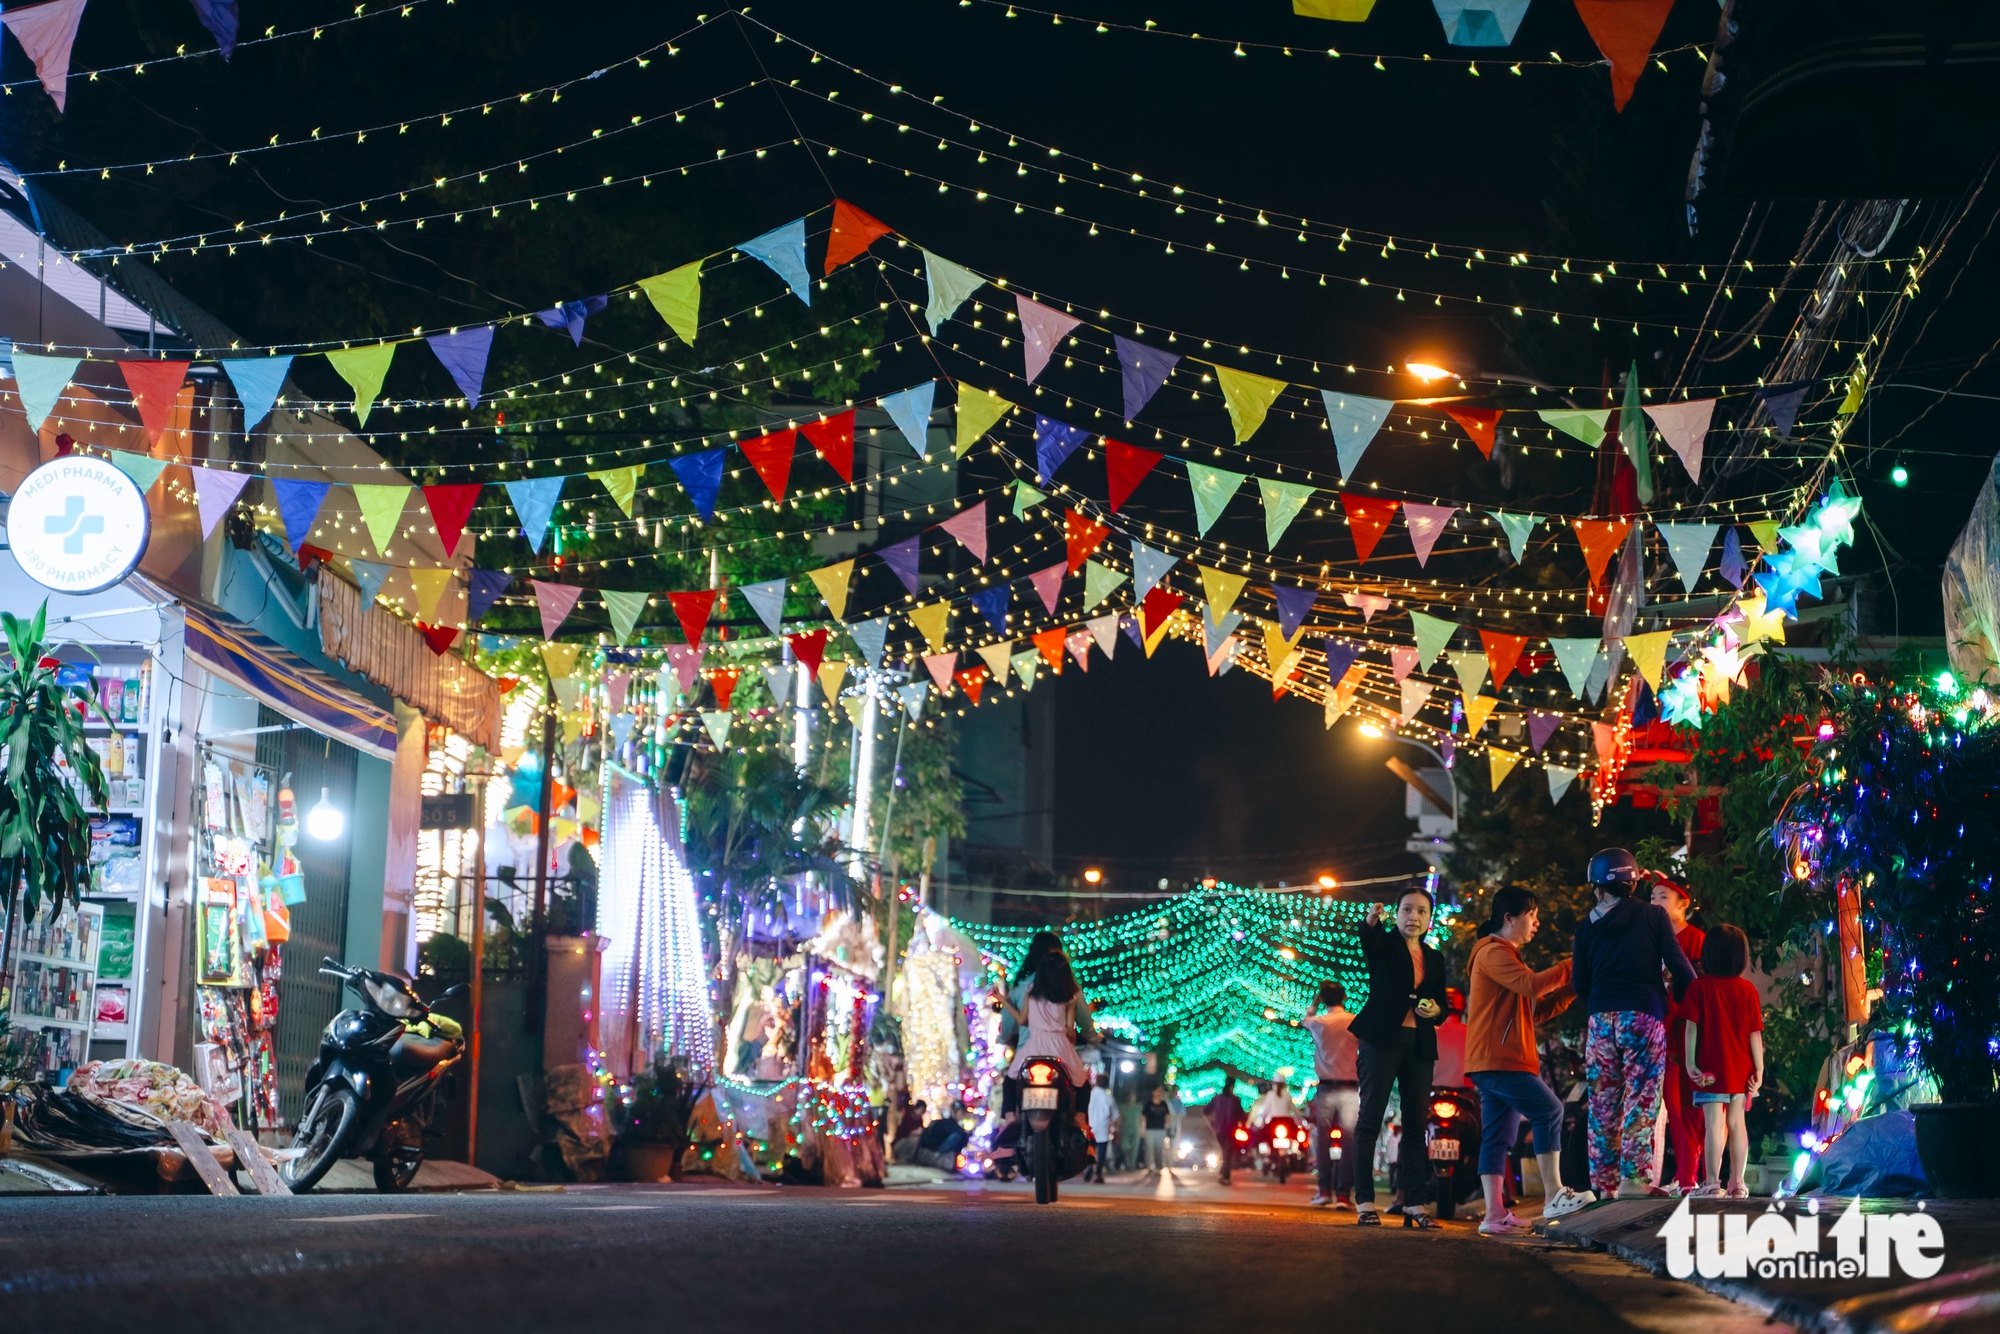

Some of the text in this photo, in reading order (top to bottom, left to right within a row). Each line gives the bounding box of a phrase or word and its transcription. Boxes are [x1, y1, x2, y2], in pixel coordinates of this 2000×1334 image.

[24, 467, 123, 498] MEDI PHARMA
[25, 545, 122, 582] 380 PHARMACY
